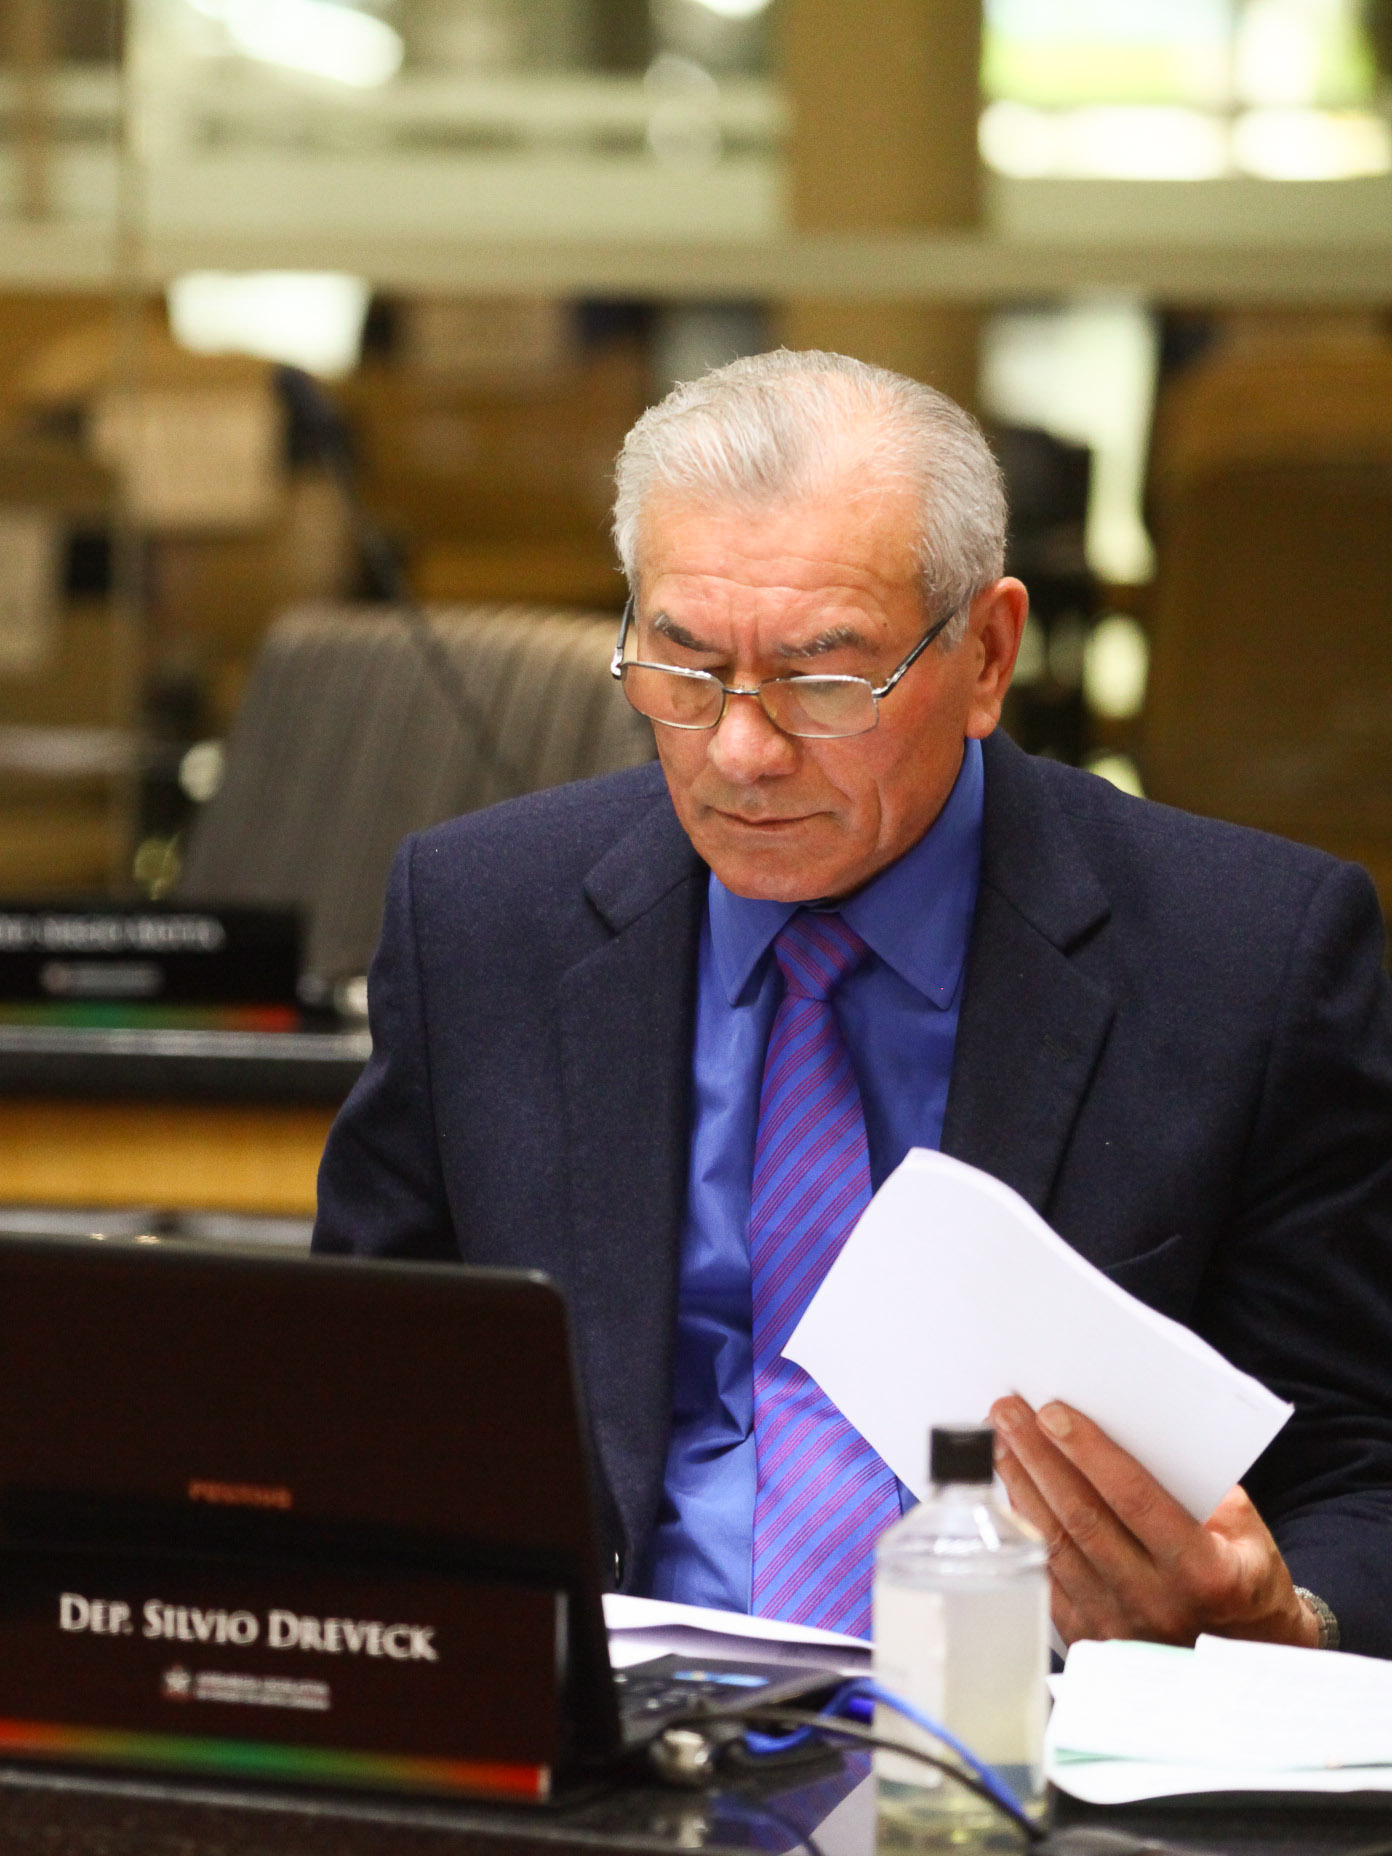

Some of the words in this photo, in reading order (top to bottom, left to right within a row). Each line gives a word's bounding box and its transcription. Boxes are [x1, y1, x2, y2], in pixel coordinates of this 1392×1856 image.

[60, 1592, 134, 1636] DEP.
[142, 1598, 259, 1646] SILVIO
[268, 1608, 439, 1661] DREVECK
